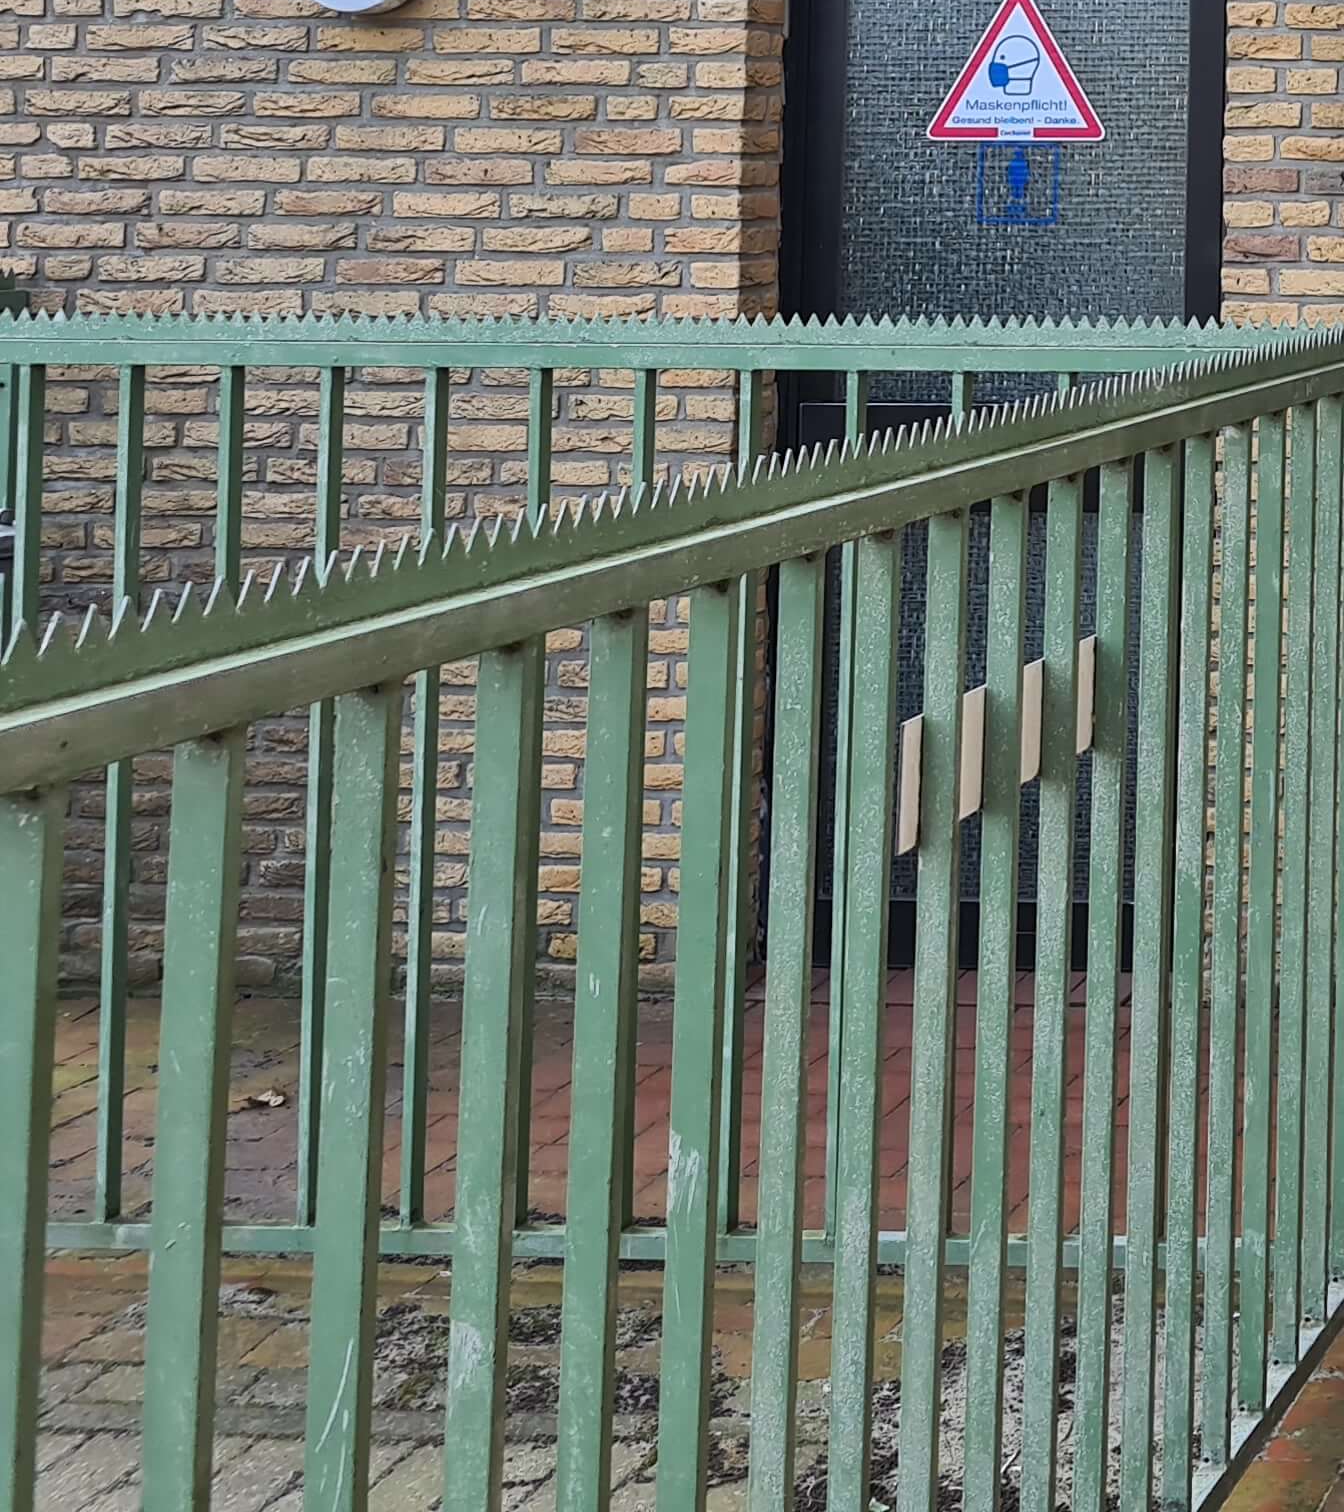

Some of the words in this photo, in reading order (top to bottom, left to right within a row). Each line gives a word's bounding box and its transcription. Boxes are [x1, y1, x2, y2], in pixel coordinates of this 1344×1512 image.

[965, 99, 1068, 112] Maskenpflicht!
[952, 116, 991, 124] Gesund
[994, 116, 1034, 124] bleiben!
